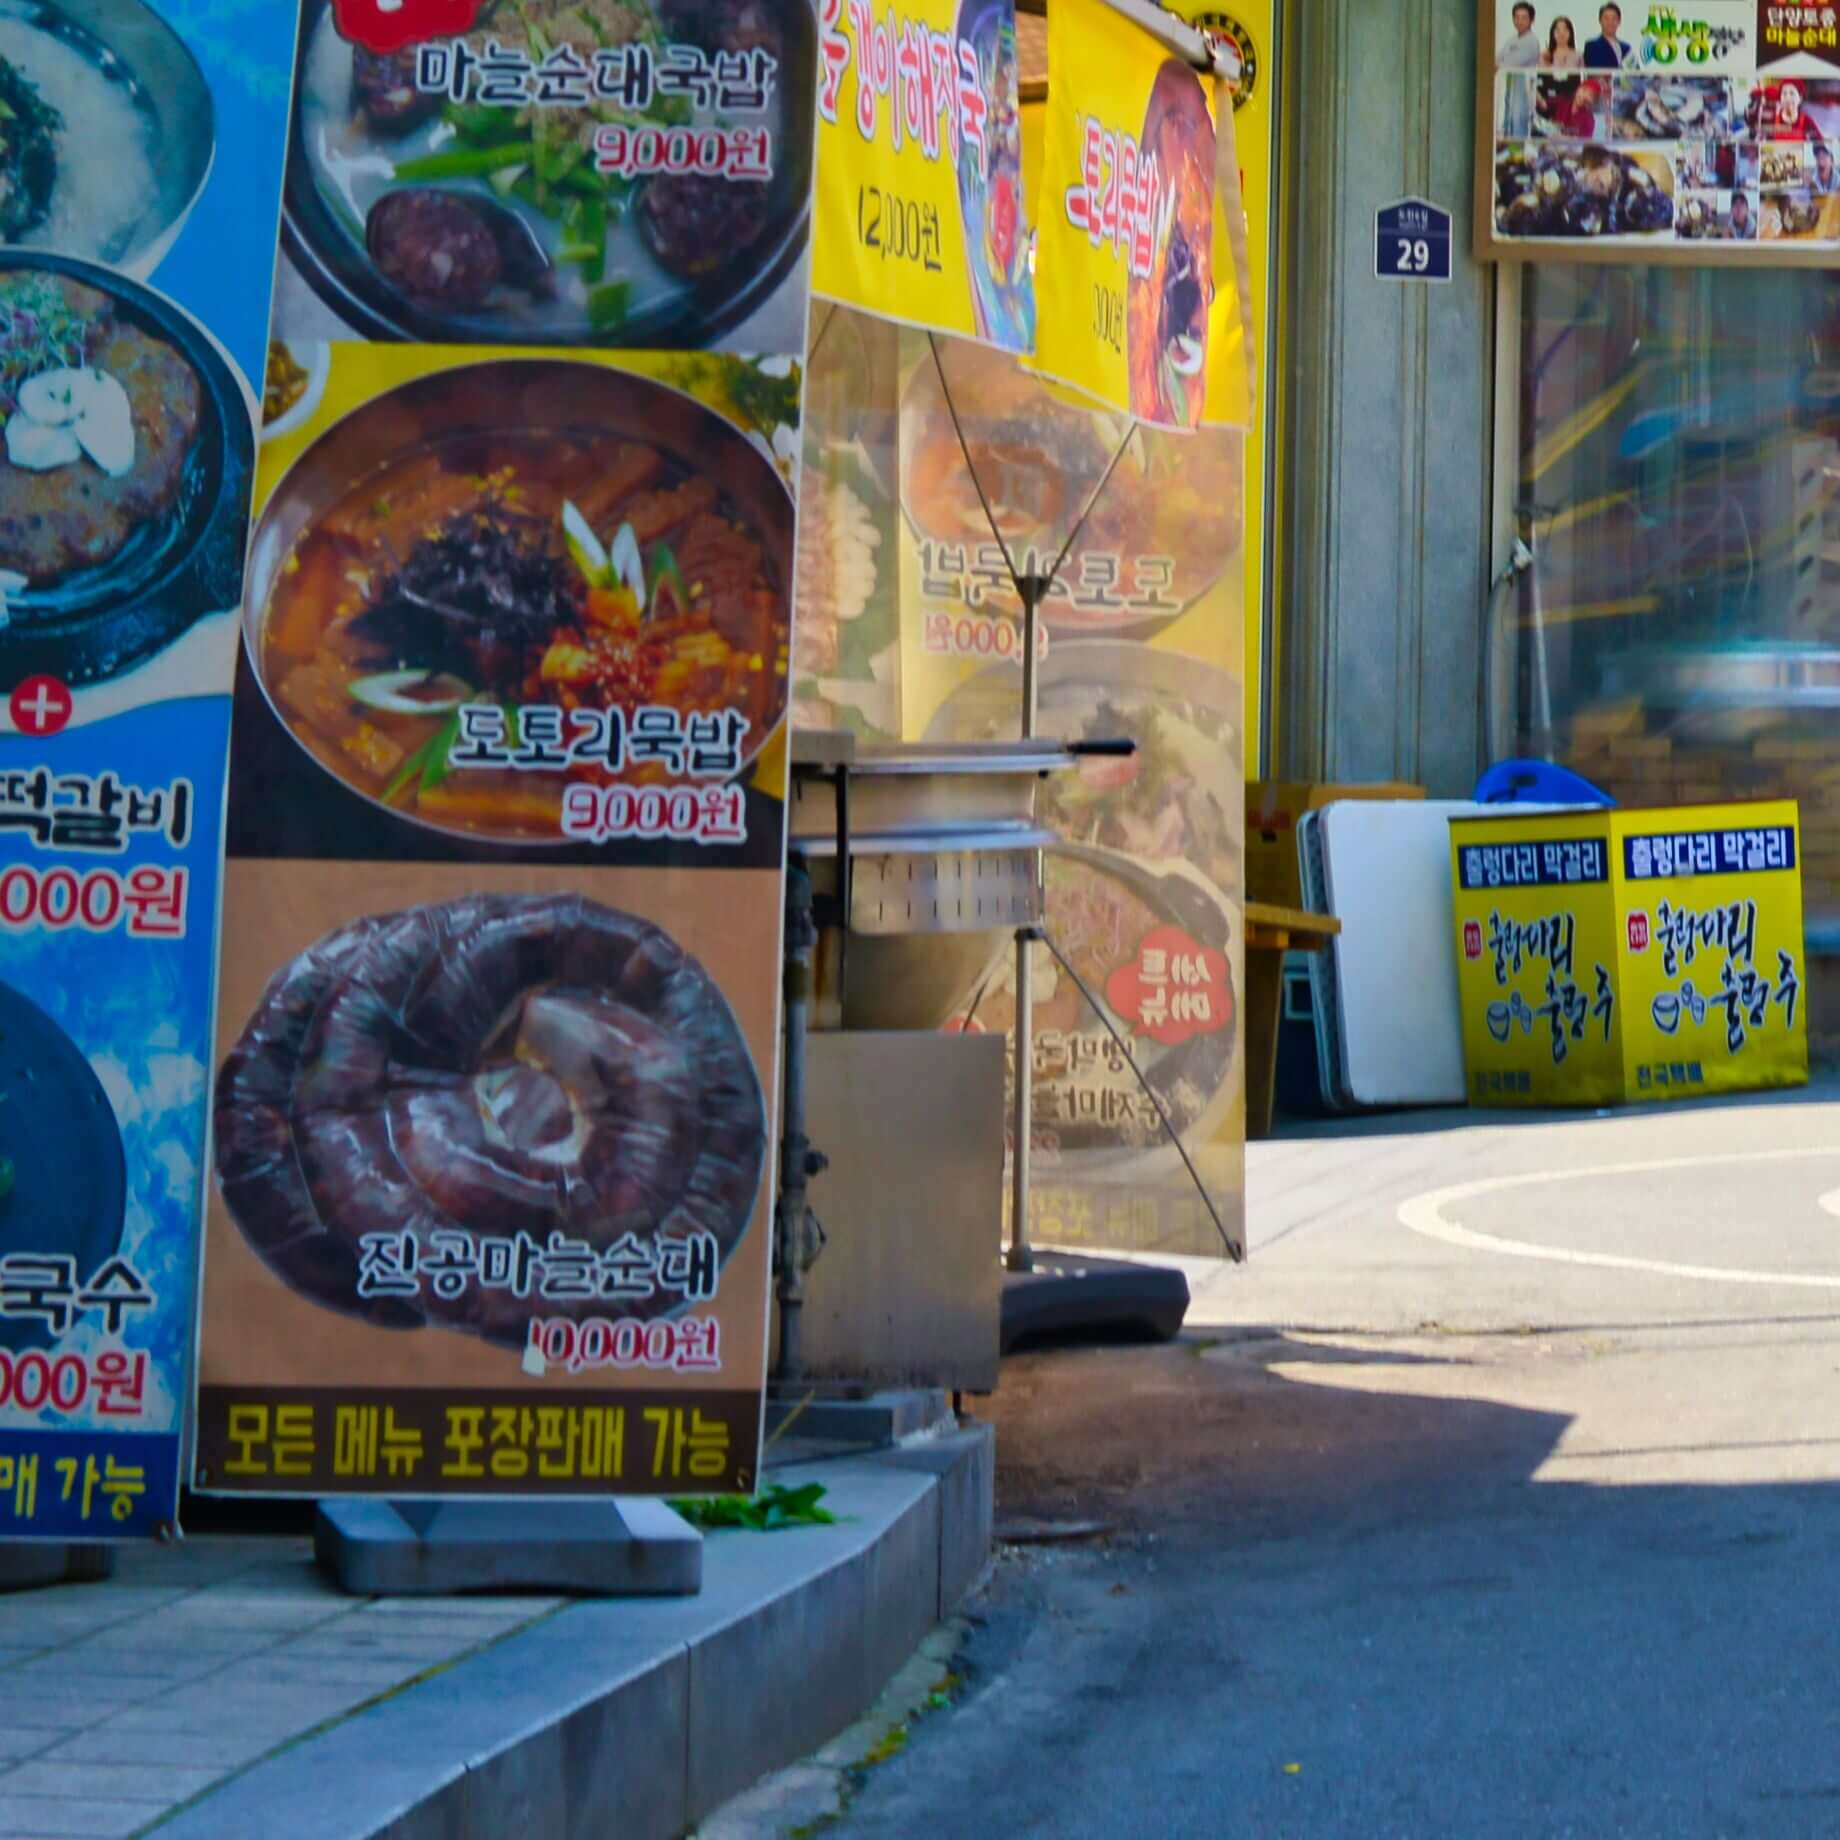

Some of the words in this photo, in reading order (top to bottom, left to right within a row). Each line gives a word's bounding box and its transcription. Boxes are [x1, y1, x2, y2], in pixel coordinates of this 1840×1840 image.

[413, 40, 779, 113] 마늘순대국밥
[596, 126, 776, 180] 9,000원
[856, 183, 943, 272] 12,000원
[1065, 113, 1161, 280] 토리묵밥
[1396, 238, 1430, 272] 29
[449, 705, 752, 774] 도토리묵밥
[559, 783, 750, 842] 9,000원
[1464, 844, 1538, 884] 출렁다리
[1545, 841, 1601, 881] 막걸리
[1630, 831, 1717, 877] 출렁다리
[1721, 828, 1788, 872] 막걸리
[0, 1252, 157, 1337] 국수
[357, 1231, 721, 1300] 진공마늘순대
[527, 1316, 722, 1375] 10,000원
[222, 1401, 318, 1476] 모든
[333, 1404, 425, 1480] 메뉴
[439, 1403, 625, 1481] 포장판매
[642, 1407, 732, 1478] 가능
[54, 1454, 147, 1523] 가능
